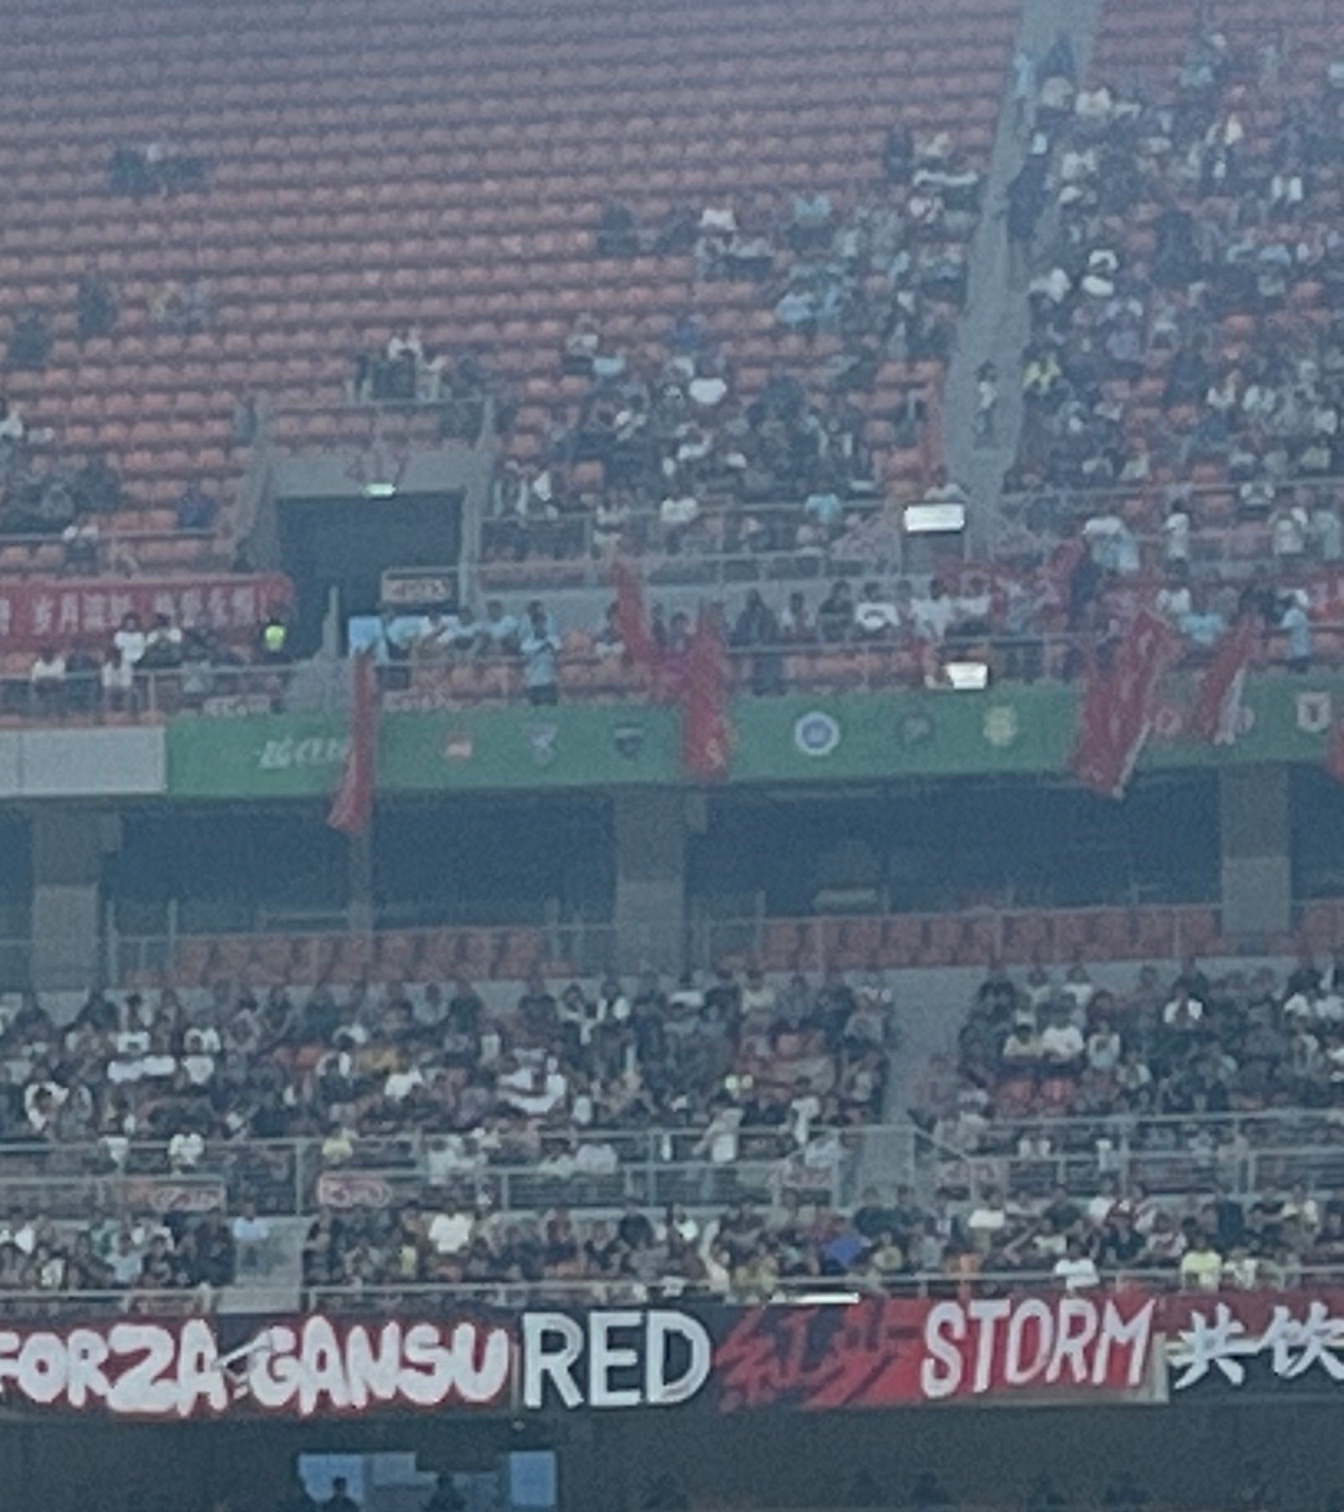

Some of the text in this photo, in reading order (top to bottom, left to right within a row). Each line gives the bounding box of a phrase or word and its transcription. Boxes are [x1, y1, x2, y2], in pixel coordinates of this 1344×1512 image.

[244, 1312, 510, 1416] GANSU
[523, 1311, 711, 1408] RED
[920, 1299, 1156, 1398] STORM
